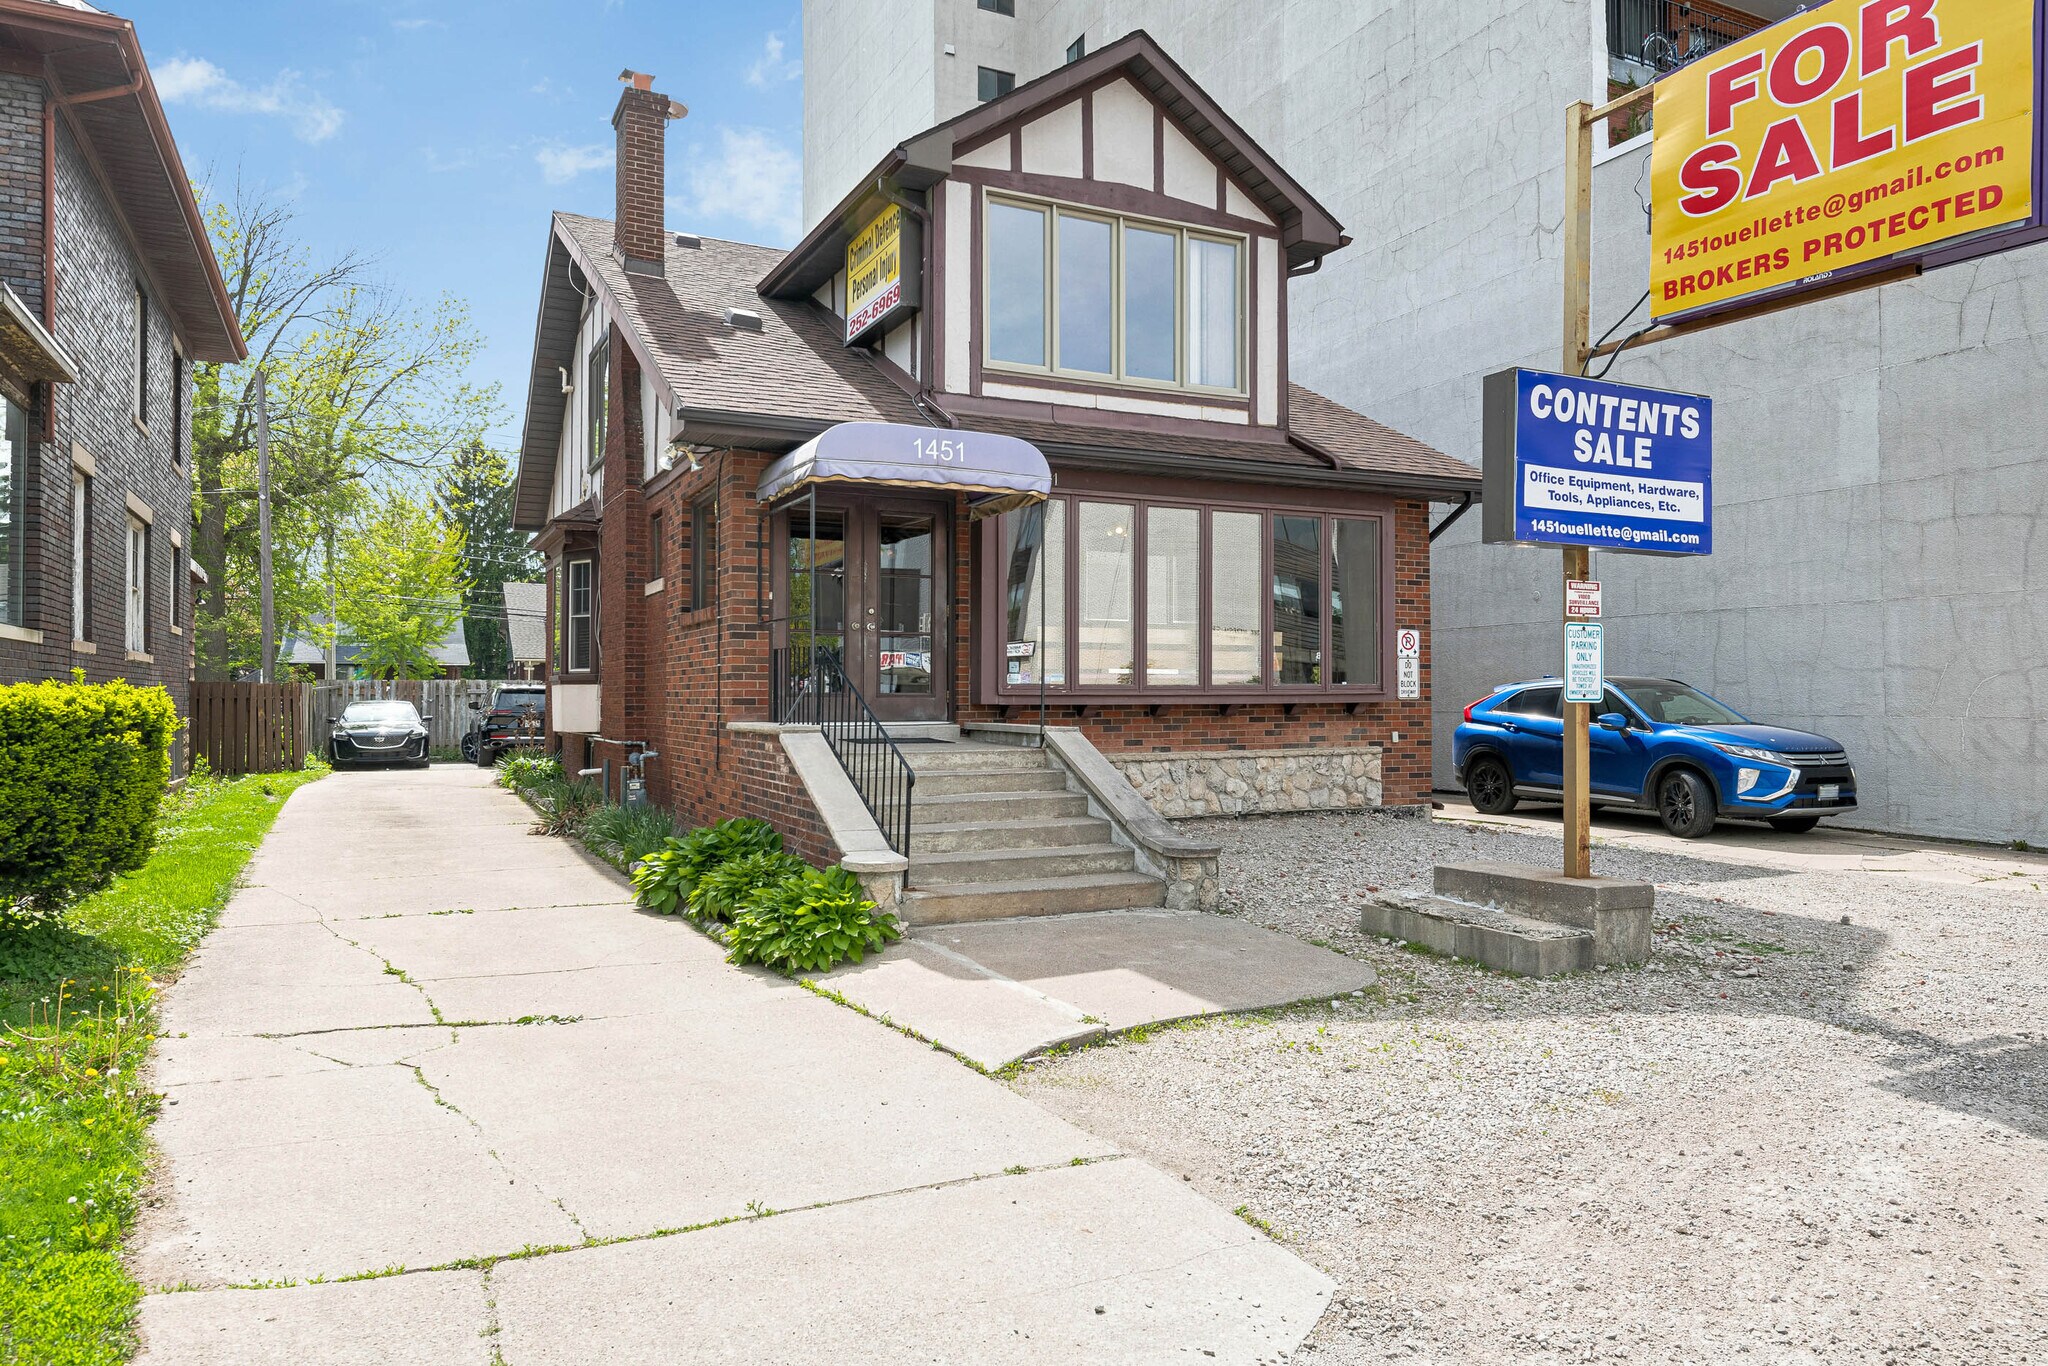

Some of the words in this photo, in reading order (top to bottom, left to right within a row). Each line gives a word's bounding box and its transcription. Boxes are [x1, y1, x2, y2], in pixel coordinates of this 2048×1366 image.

[1706, 0, 1942, 139] FOR
[1678, 39, 1985, 218] SALE
[1664, 145, 2005, 265] 1451ouellette@gmail.com
[849, 229, 874, 273] Criminal
[1663, 248, 1790, 301] BROKERS
[1803, 184, 2004, 262] PROTECTED
[852, 260, 878, 303] Personal
[880, 249, 897, 283] Injury
[849, 284, 900, 337] 252-6969
[1530, 384, 1700, 439] CONTENTS
[913, 438, 964, 462] 1451
[1573, 429, 1652, 469] SALE
[1529, 470, 1565, 486] Office
[1569, 475, 1634, 495] Equipment,
[1638, 483, 1700, 500] Hardware,
[1548, 490, 1583, 505] Tools,
[1587, 494, 1655, 512] Appliances,
[1658, 500, 1681, 513] Etc.
[1531, 519, 1700, 544] 1451ouellette@gmail.com
[1568, 629, 1600, 639] CUSTOMER
[1571, 641, 1597, 650] PARKING
[1404, 661, 1412, 669] DO
[1576, 652, 1592, 661] ONLY
[1401, 680, 1416, 688] BLOCK
